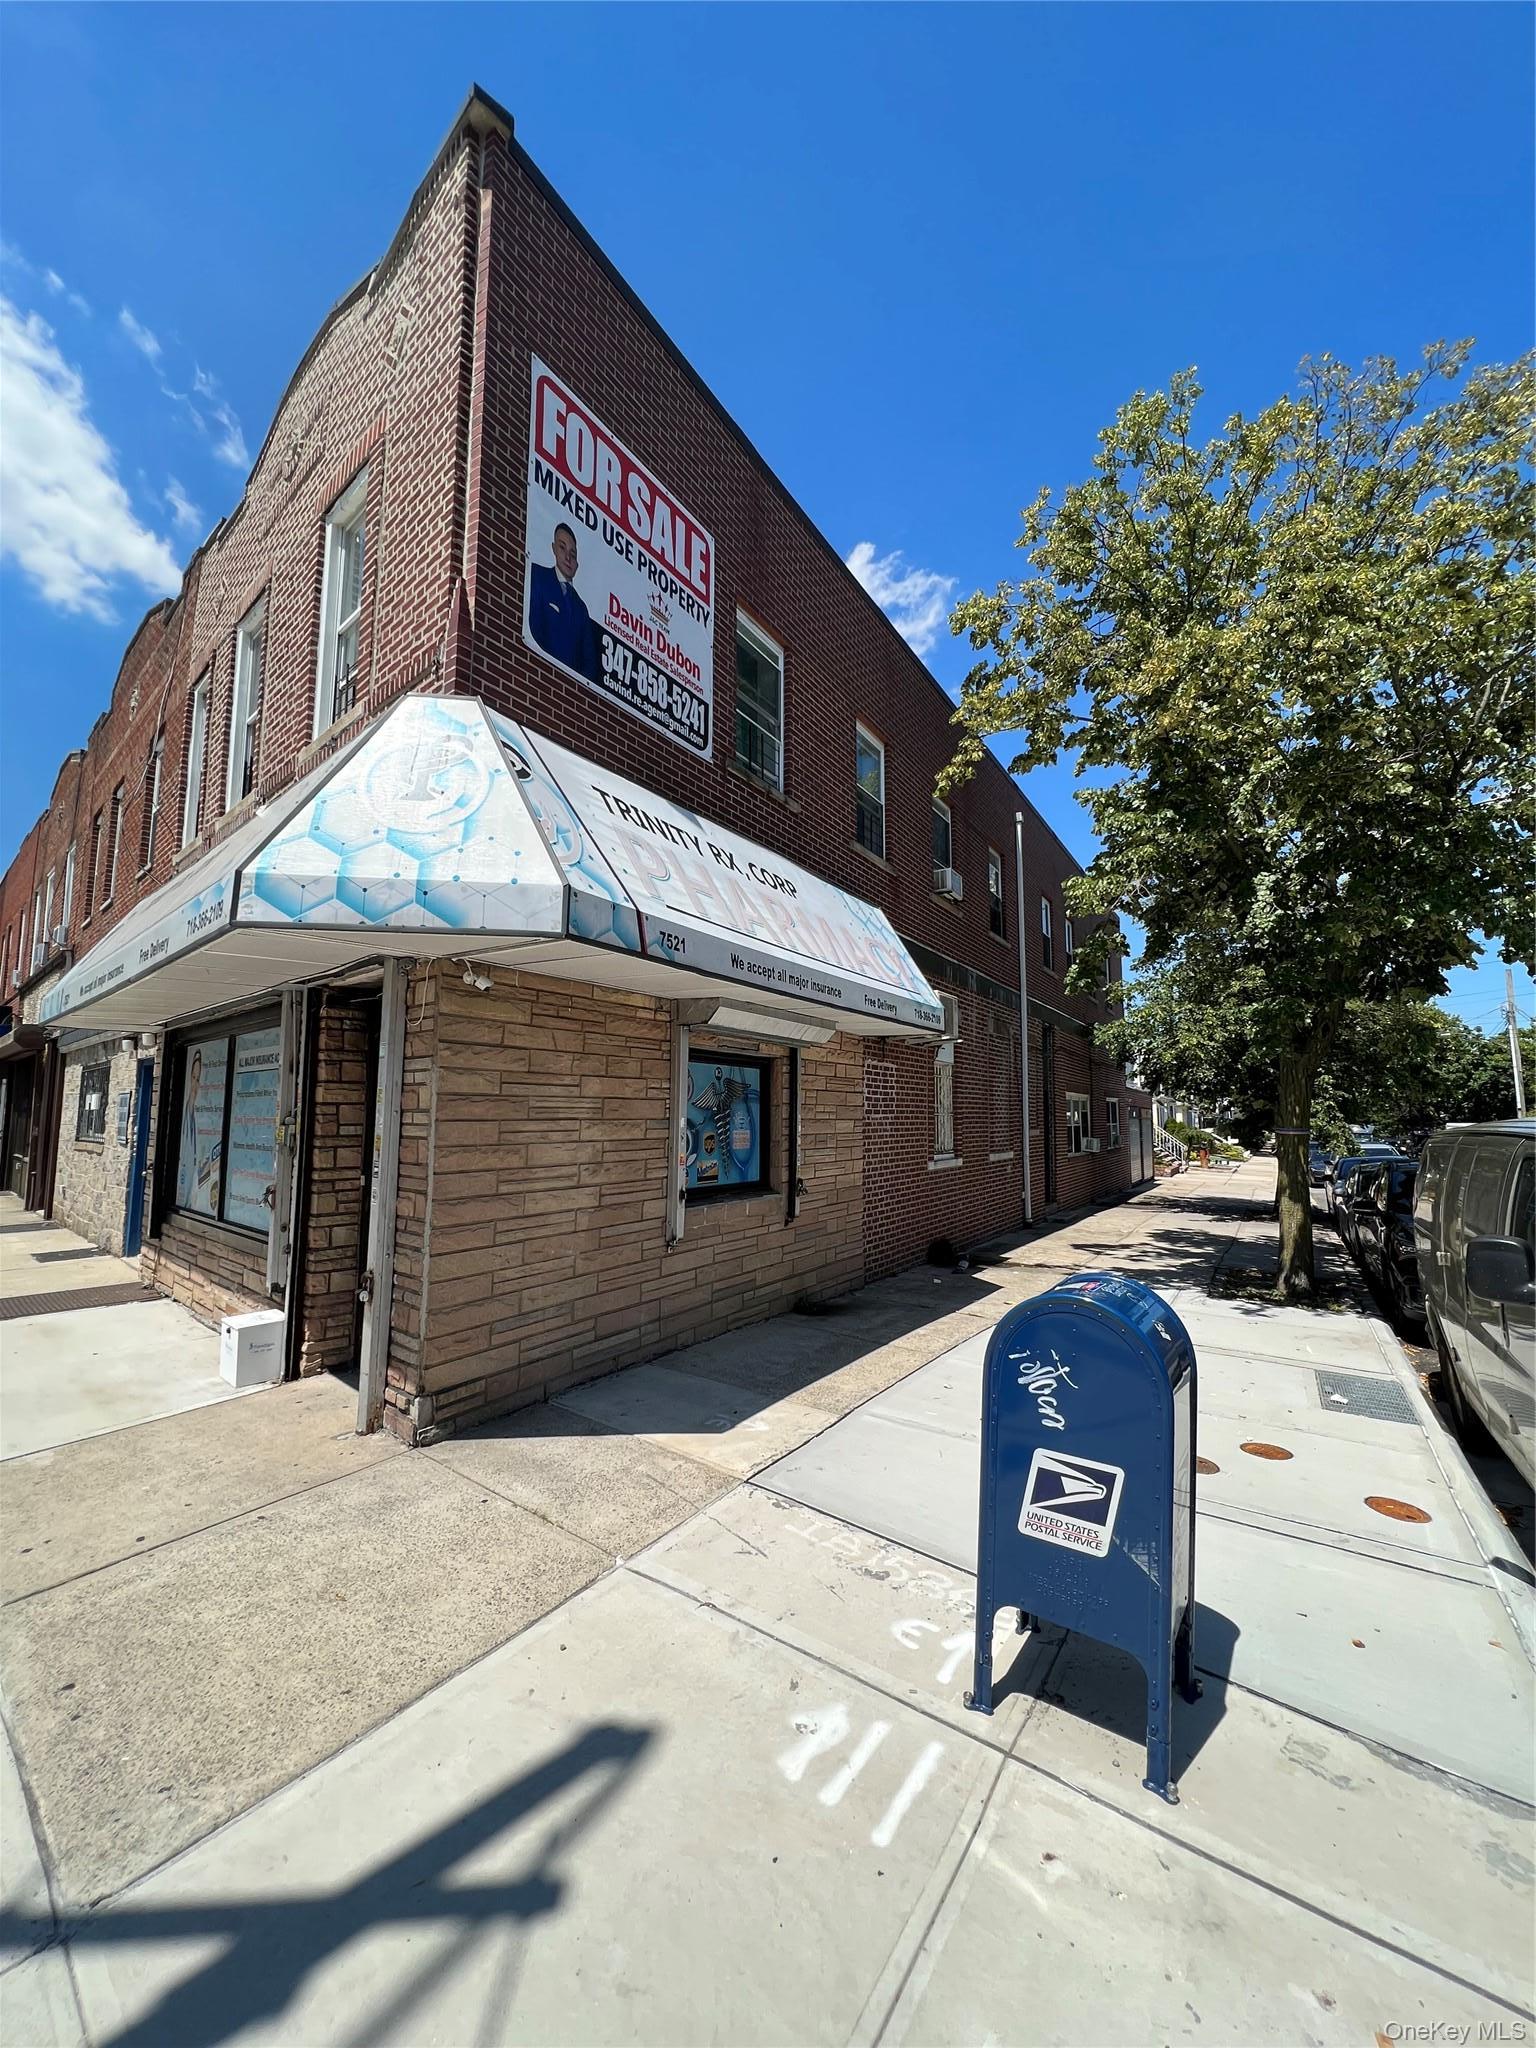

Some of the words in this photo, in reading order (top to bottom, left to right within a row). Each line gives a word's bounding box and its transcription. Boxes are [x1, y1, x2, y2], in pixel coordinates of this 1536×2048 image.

[542, 382, 622, 519] FOR
[627, 471, 707, 597] SALE
[534, 457, 599, 532] MIXED
[602, 518, 634, 566] USE
[637, 547, 710, 629] PROPERTY
[604, 614, 635, 645] Licensed
[635, 637, 650, 657] Real
[651, 649, 669, 671] Estate
[669, 662, 704, 695] Salesperson
[609, 591, 653, 646] Davin
[656, 631, 701, 682] Dubon
[601, 633, 705, 736] 347-858-5241
[603, 673, 704, 748] davind.re.agent@gmail.com
[591, 784, 705, 858] TRINITY
[706, 841, 744, 876] RX
[139, 946, 149, 965] Free
[150, 937, 170, 959] Delivery
[659, 930, 687, 955] 7521
[730, 952, 746, 972] We
[747, 961, 776, 981] accept
[777, 969, 788, 984] all
[788, 974, 809, 992] major
[810, 979, 843, 999] insurance
[864, 994, 877, 1008] Free
[877, 998, 898, 1016] Delivery
[1024, 1520, 1061, 1539] POSTAL
[1061, 1531, 1104, 1552] SERVICE
[1026, 1510, 1064, 1528] UNITED
[1064, 1521, 1100, 1539] STATES
